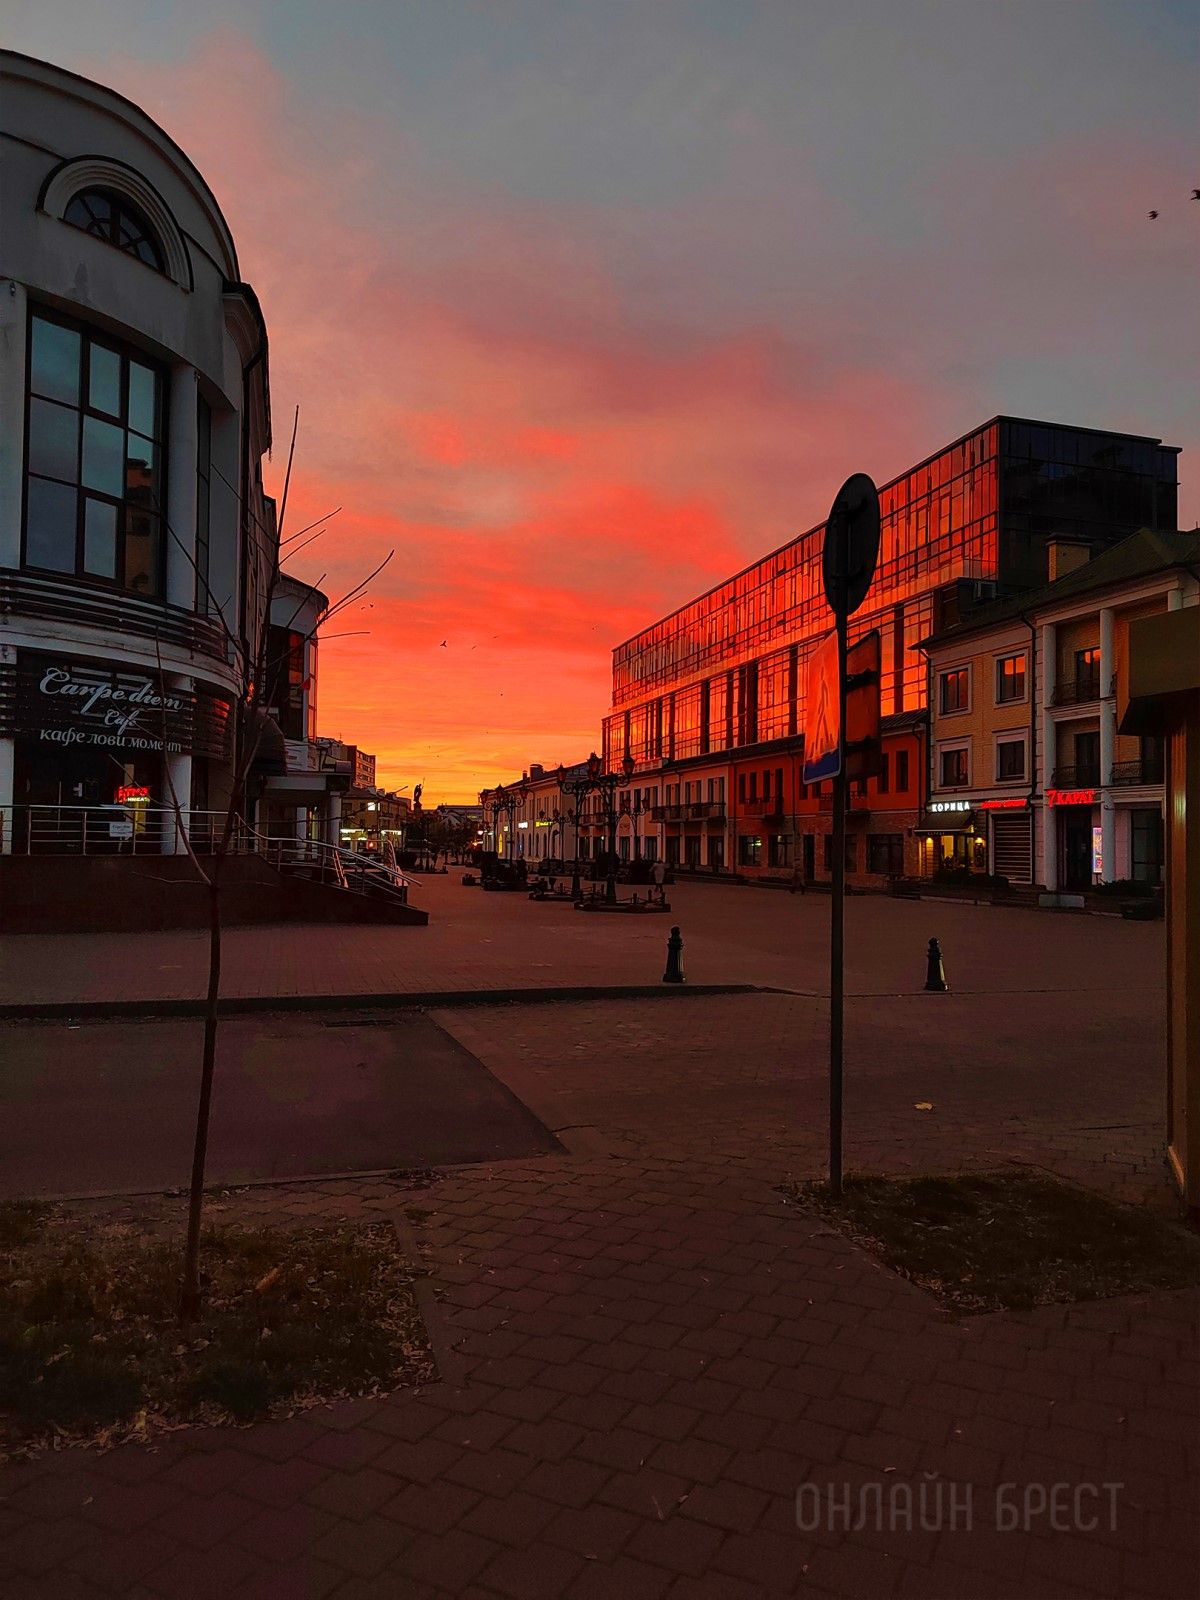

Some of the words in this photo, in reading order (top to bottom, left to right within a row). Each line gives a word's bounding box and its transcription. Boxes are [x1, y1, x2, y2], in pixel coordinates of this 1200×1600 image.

[39, 667, 126, 715] Carpe
[40, 727, 85, 746] кафе
[86, 734, 125, 747] лови
[128, 737, 182, 753] момент
[931, 801, 970, 812] КОРИЦА
